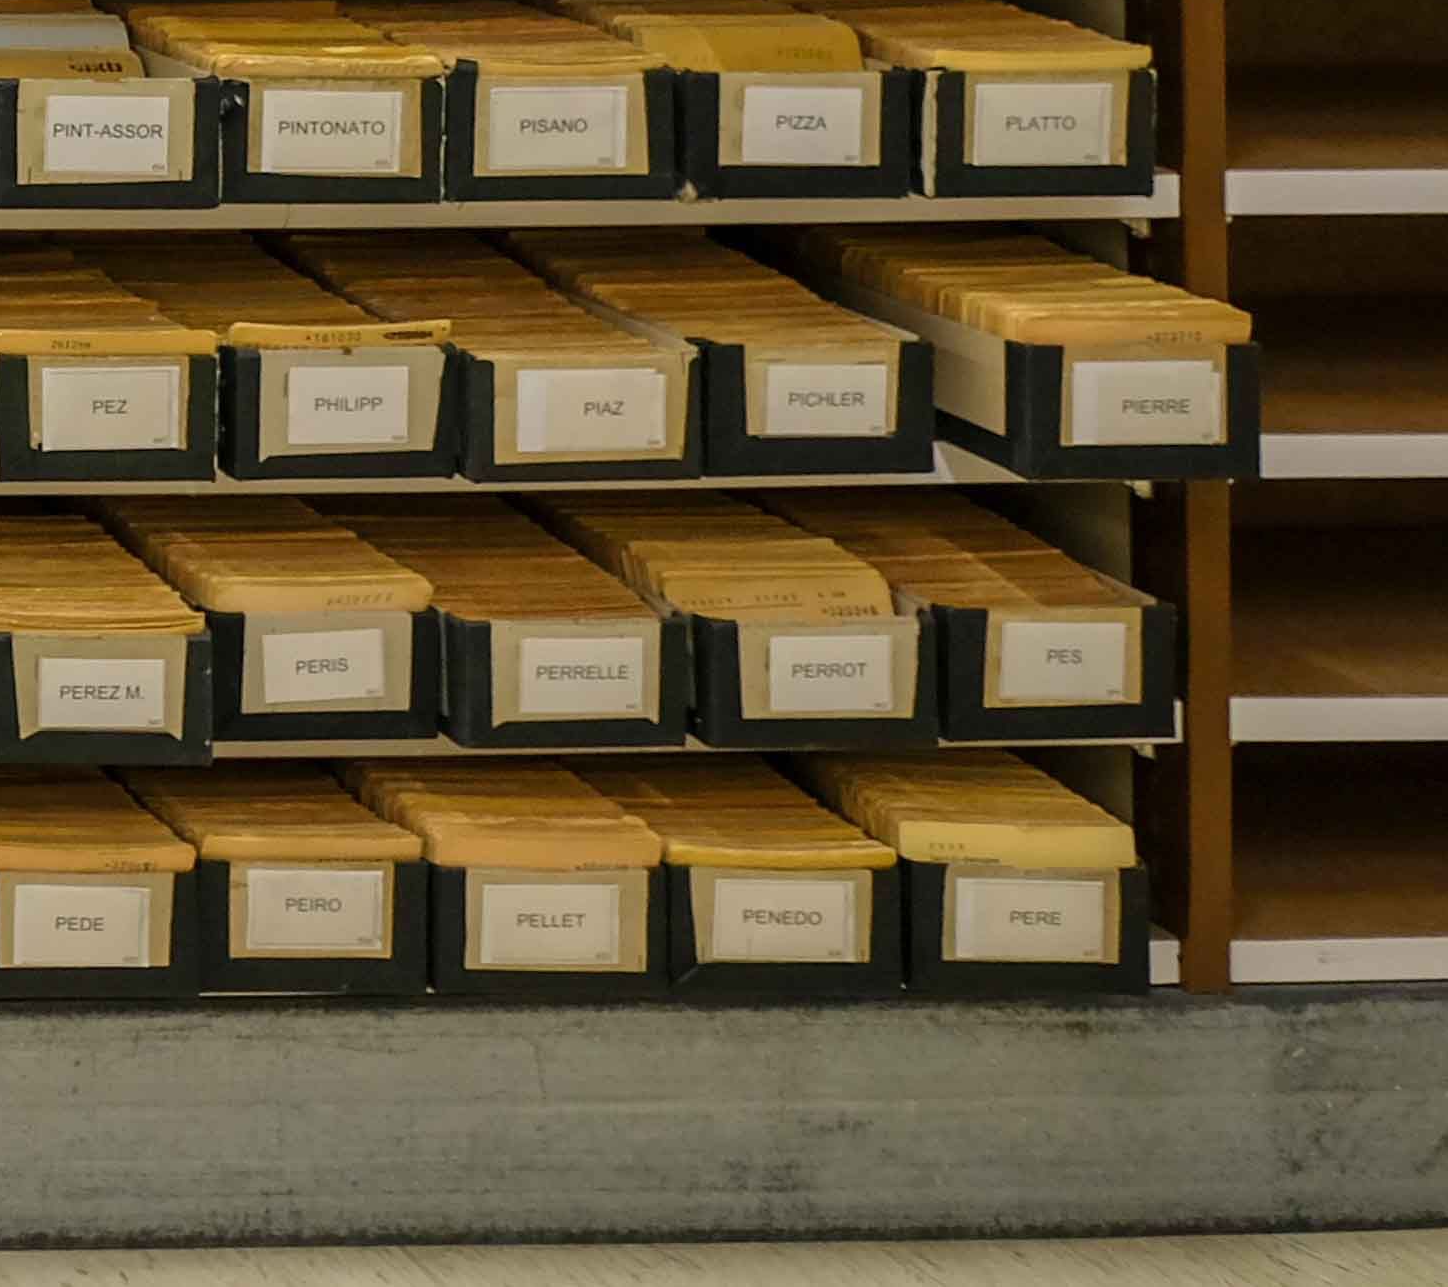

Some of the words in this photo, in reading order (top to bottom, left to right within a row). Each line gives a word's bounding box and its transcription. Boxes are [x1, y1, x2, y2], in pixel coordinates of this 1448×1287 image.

[277, 120, 386, 136] PINTONATO
[775, 114, 827, 131] PIZZA
[314, 396, 384, 413] PHILIPP
[582, 399, 626, 417] PIAZ
[295, 657, 350, 676] PERIS
[535, 664, 629, 681] PERRELLE
[59, 684, 121, 700] PEREZ
[516, 912, 587, 929] PELLET
[742, 908, 823, 926] PENEDO
